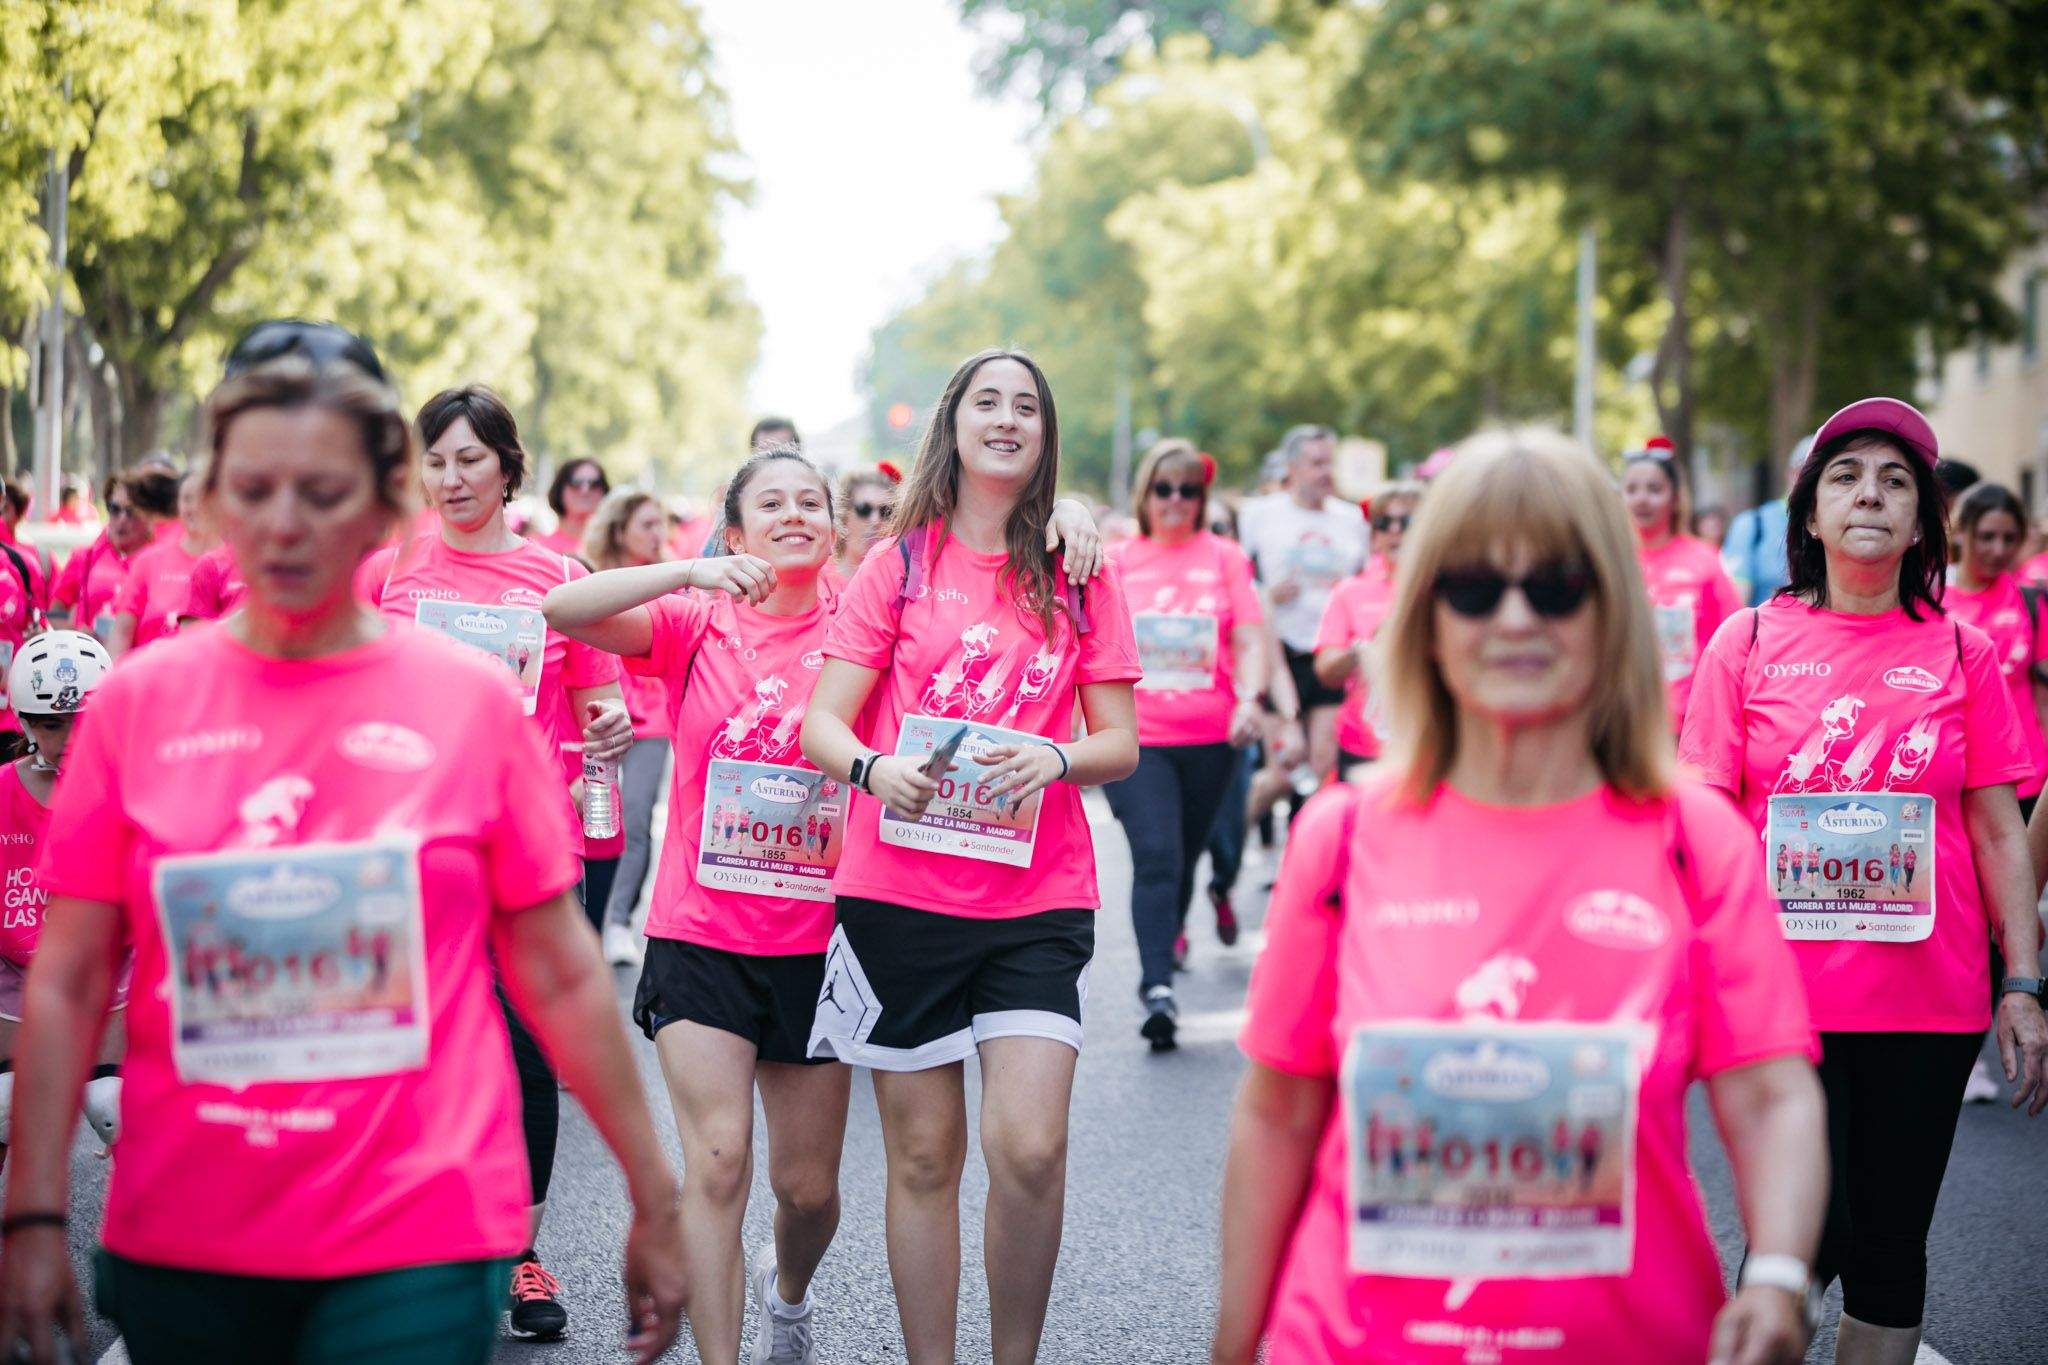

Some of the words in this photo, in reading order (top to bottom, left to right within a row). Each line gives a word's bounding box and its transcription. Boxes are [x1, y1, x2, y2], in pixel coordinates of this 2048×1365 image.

[408, 588, 460, 601] OYSHO
[459, 617, 505, 630] ASTURIANA
[717, 637, 757, 661] OYSO
[1764, 662, 1832, 679] OYSHO
[757, 782, 807, 800] ASTURIANA
[937, 777, 994, 806] 016
[946, 806, 973, 819] 1854
[1822, 814, 1884, 828] ASTURIANA
[752, 821, 803, 847] 016
[934, 817, 944, 826] DE
[944, 818, 955, 828] LA
[956, 819, 981, 833] MUJER
[986, 825, 1016, 838] MADRID
[0, 833, 34, 845] YSHO
[895, 826, 942, 843] OYSHO
[970, 841, 1016, 856] Santander
[761, 849, 786, 861] 1855
[716, 855, 748, 867] CARRERA
[749, 859, 759, 868] DE
[760, 860, 770, 870] LA
[771, 861, 794, 873] MUJER
[799, 865, 827, 877] MADRID
[1823, 858, 1885, 882] 016
[713, 870, 758, 886] OYSHO
[784, 880, 827, 894] Santander
[4, 887, 49, 907] GAN
[1836, 888, 1866, 899] 1962
[1787, 901, 1824, 911] CARRERA
[1825, 901, 1837, 911] DE
[1837, 901, 1848, 911] LA
[1849, 902, 1877, 911] MUJER
[1883, 903, 1914, 912] MADRID
[3, 907, 37, 928] LAS
[1786, 919, 1837, 931] OYSHO
[1868, 921, 1916, 933] Santander
